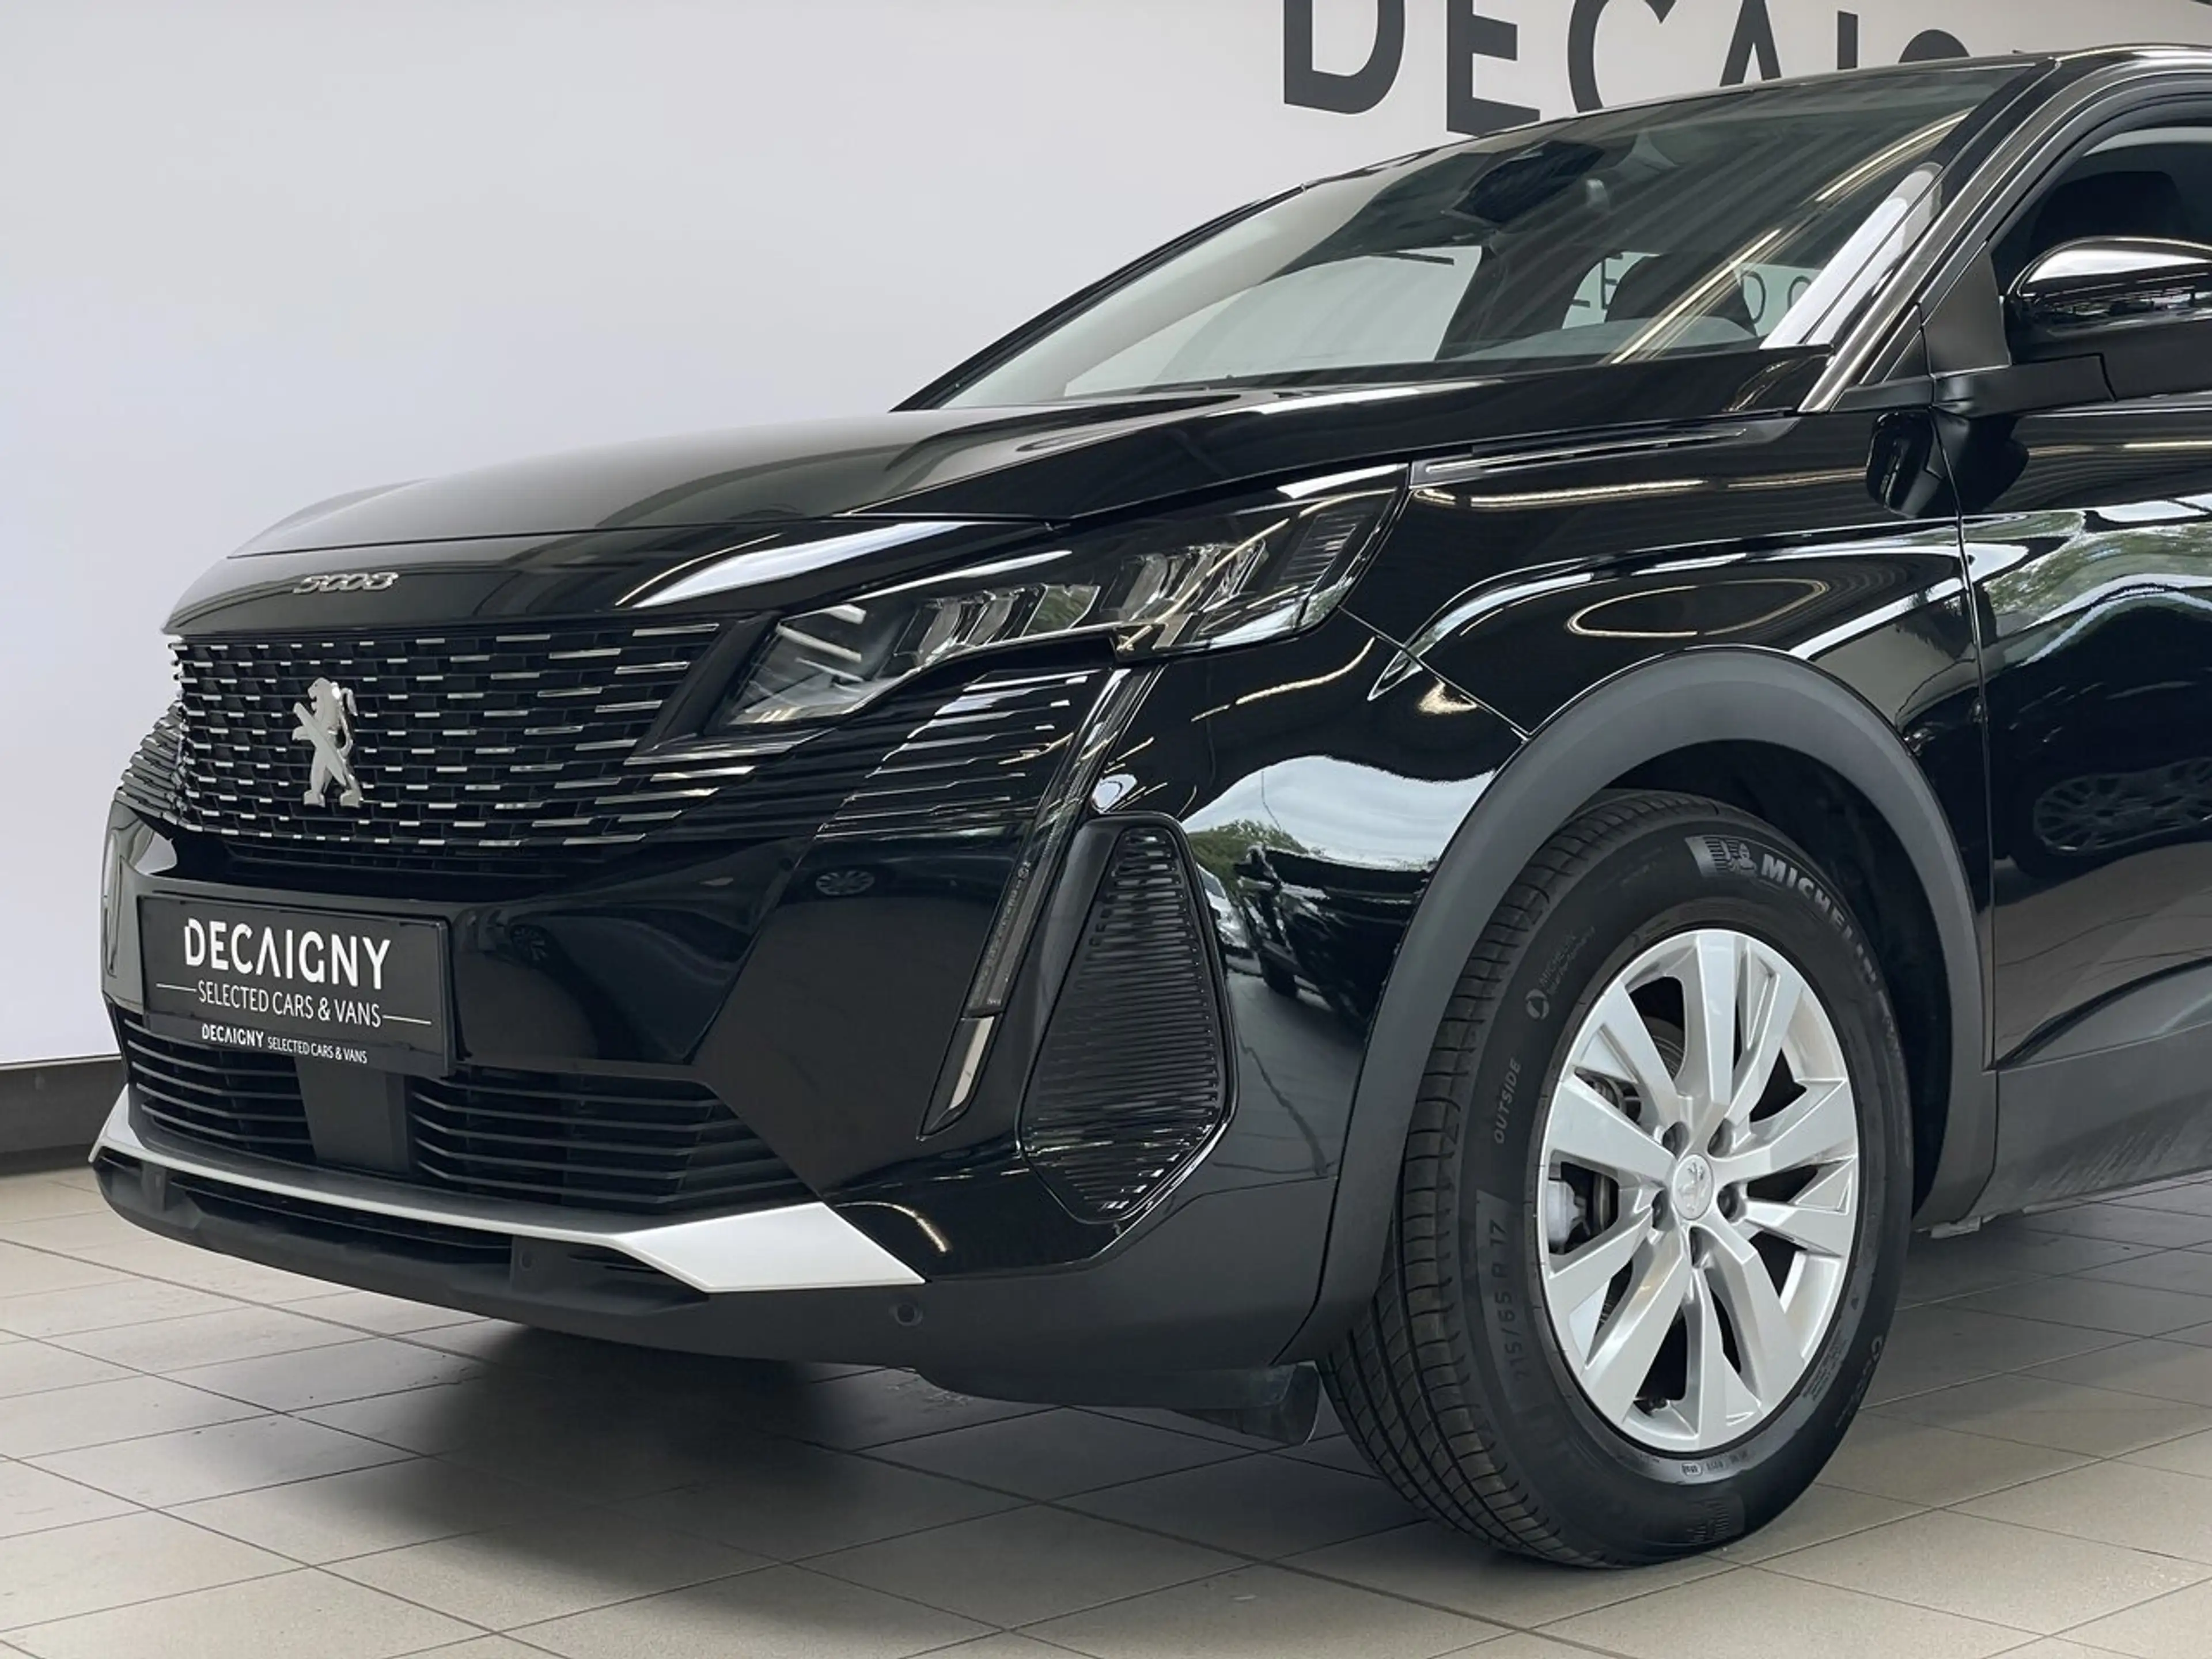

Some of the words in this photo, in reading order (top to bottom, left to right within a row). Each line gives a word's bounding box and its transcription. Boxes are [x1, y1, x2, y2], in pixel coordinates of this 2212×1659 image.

[184, 917, 391, 990] DECAIGNY
[198, 980, 269, 1013] SELECTED
[272, 991, 313, 1020] CARS
[317, 997, 331, 1021] &
[334, 999, 382, 1028] VANS
[202, 1023, 266, 1049] DECAIGNY
[267, 1036, 310, 1055] SELECTED
[310, 1044, 334, 1059] CARS
[335, 1048, 343, 1060] &
[343, 1048, 368, 1065] VANS
[1493, 1056, 1522, 1145] OUTSIDE
[1488, 1218, 1508, 1248] 17
